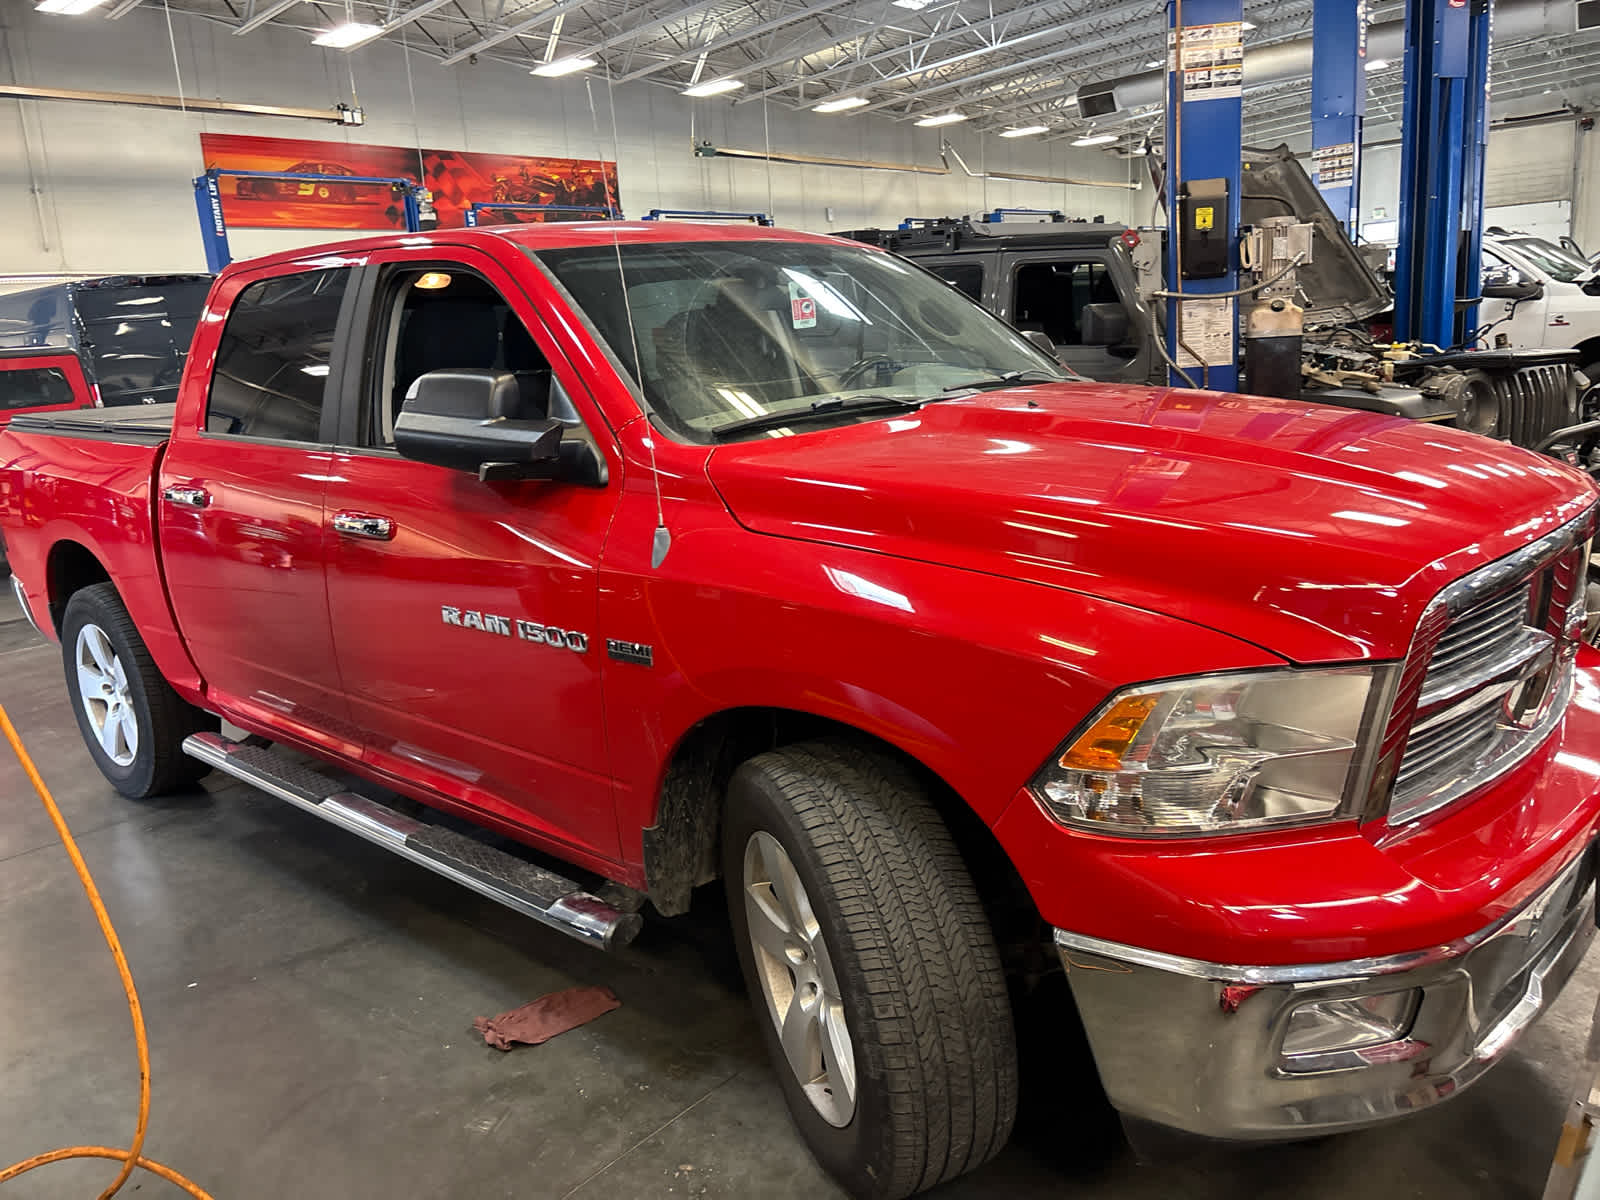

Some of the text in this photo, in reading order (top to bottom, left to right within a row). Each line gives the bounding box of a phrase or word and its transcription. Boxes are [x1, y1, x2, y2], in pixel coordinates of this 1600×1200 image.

[208, 177, 224, 232] ROTARY LIFT
[441, 605, 589, 653] RAM 1500
[607, 638, 653, 659] HEMI
